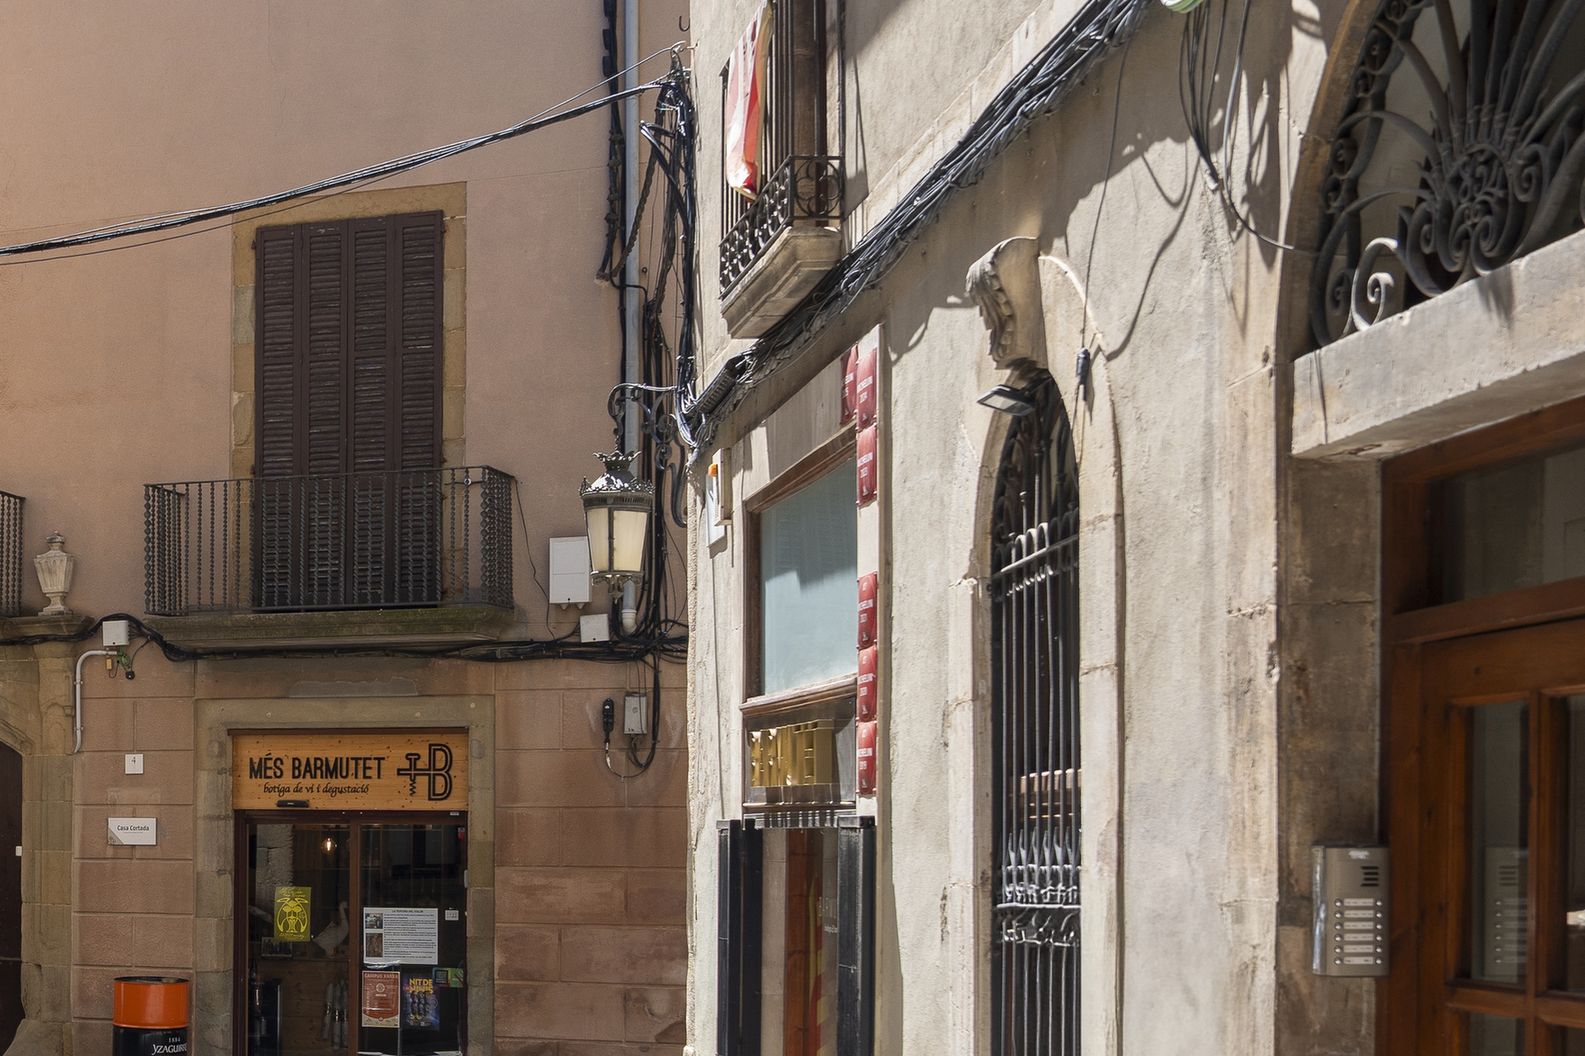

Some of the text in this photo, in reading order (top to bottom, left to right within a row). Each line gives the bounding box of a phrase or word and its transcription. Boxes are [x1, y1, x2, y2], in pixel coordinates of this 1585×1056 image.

[249, 753, 386, 779] MÉS BARMUTET
[263, 782, 290, 797] botiga
[293, 782, 303, 793] de
[305, 783, 314, 793] vi
[322, 782, 369, 797] degustació
